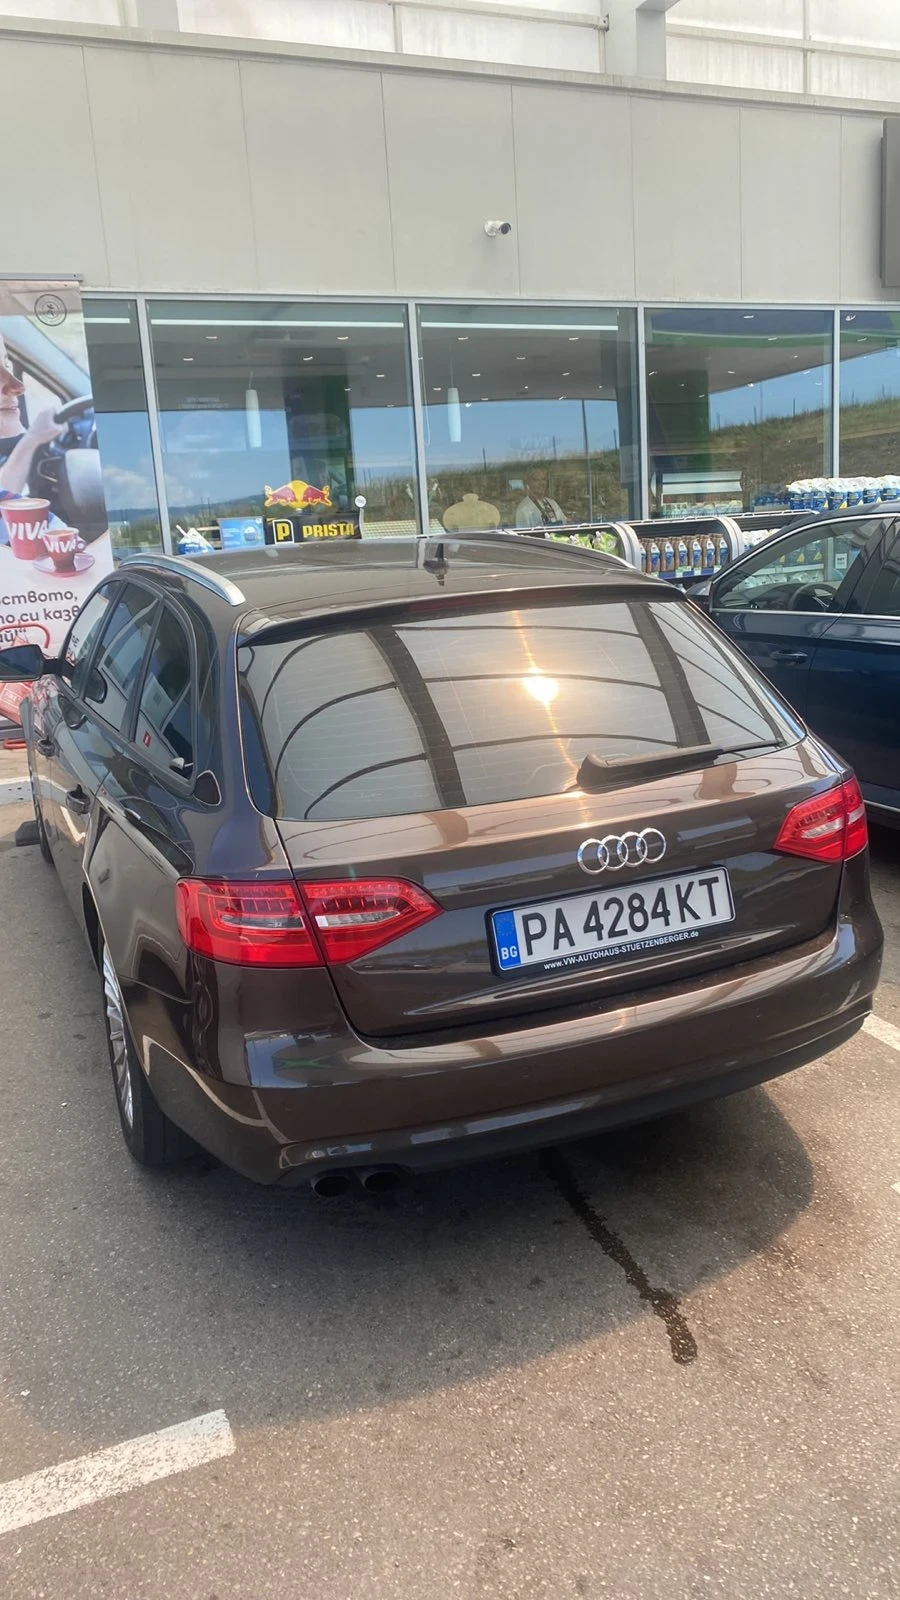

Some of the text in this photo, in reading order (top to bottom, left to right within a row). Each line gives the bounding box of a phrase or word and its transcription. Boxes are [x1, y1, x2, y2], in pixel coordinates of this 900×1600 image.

[6, 520, 48, 541] VIVA
[302, 524, 354, 538] PRISTA
[43, 540, 76, 553] VIVA
[0, 590, 77, 606] ството,
[20, 611, 39, 622] си
[521, 877, 719, 956] PA 4284 KT
[501, 946, 518, 960] BG
[543, 931, 699, 970] www.VW-AUTOHAUS-STUETZENBERGER.de
